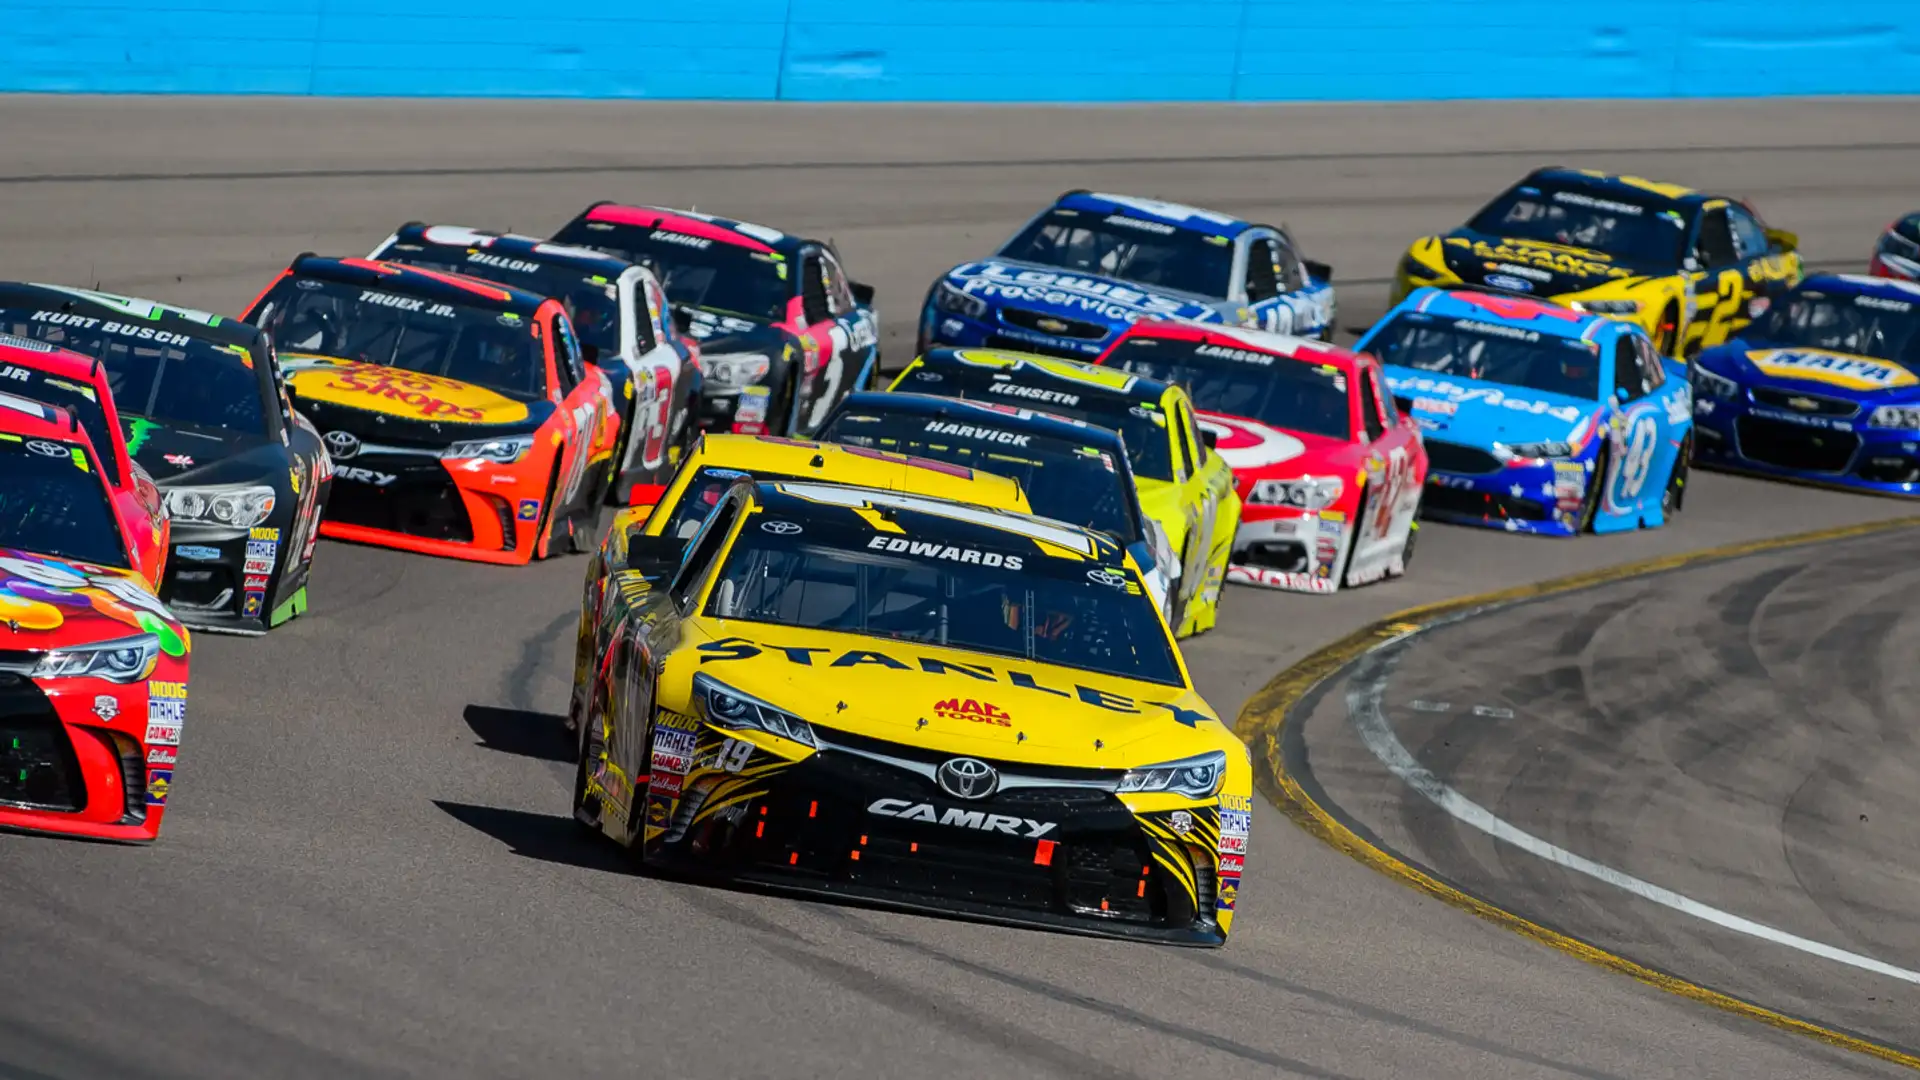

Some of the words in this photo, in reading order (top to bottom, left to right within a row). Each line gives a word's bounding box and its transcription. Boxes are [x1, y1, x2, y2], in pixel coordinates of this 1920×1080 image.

[649, 230, 712, 249] KAHNE
[467, 252, 541, 274] DILLON
[358, 290, 424, 312] TRUEX
[425, 303, 456, 318] JR.
[31, 310, 100, 329] KURT
[101, 321, 191, 348] BUSCH
[1195, 344, 1275, 366] LARSON
[326, 376, 487, 420] Shops
[988, 381, 1080, 408] KENSETH
[924, 420, 1031, 448] HARVICK
[332, 463, 397, 487] MRY
[250, 528, 279, 541] MOOG
[866, 534, 1024, 572] EDWARDS
[149, 680, 188, 699] MOOG
[695, 636, 1215, 729] STANLEY
[149, 701, 185, 720] MAHLE
[657, 710, 700, 730] MOOG
[933, 698, 1011, 720] MAC
[934, 710, 1012, 728] TOOLS
[655, 730, 697, 752] MAHLE
[711, 737, 757, 774] 19
[1220, 794, 1252, 811] MOOG
[866, 797, 1059, 839] CAMRY
